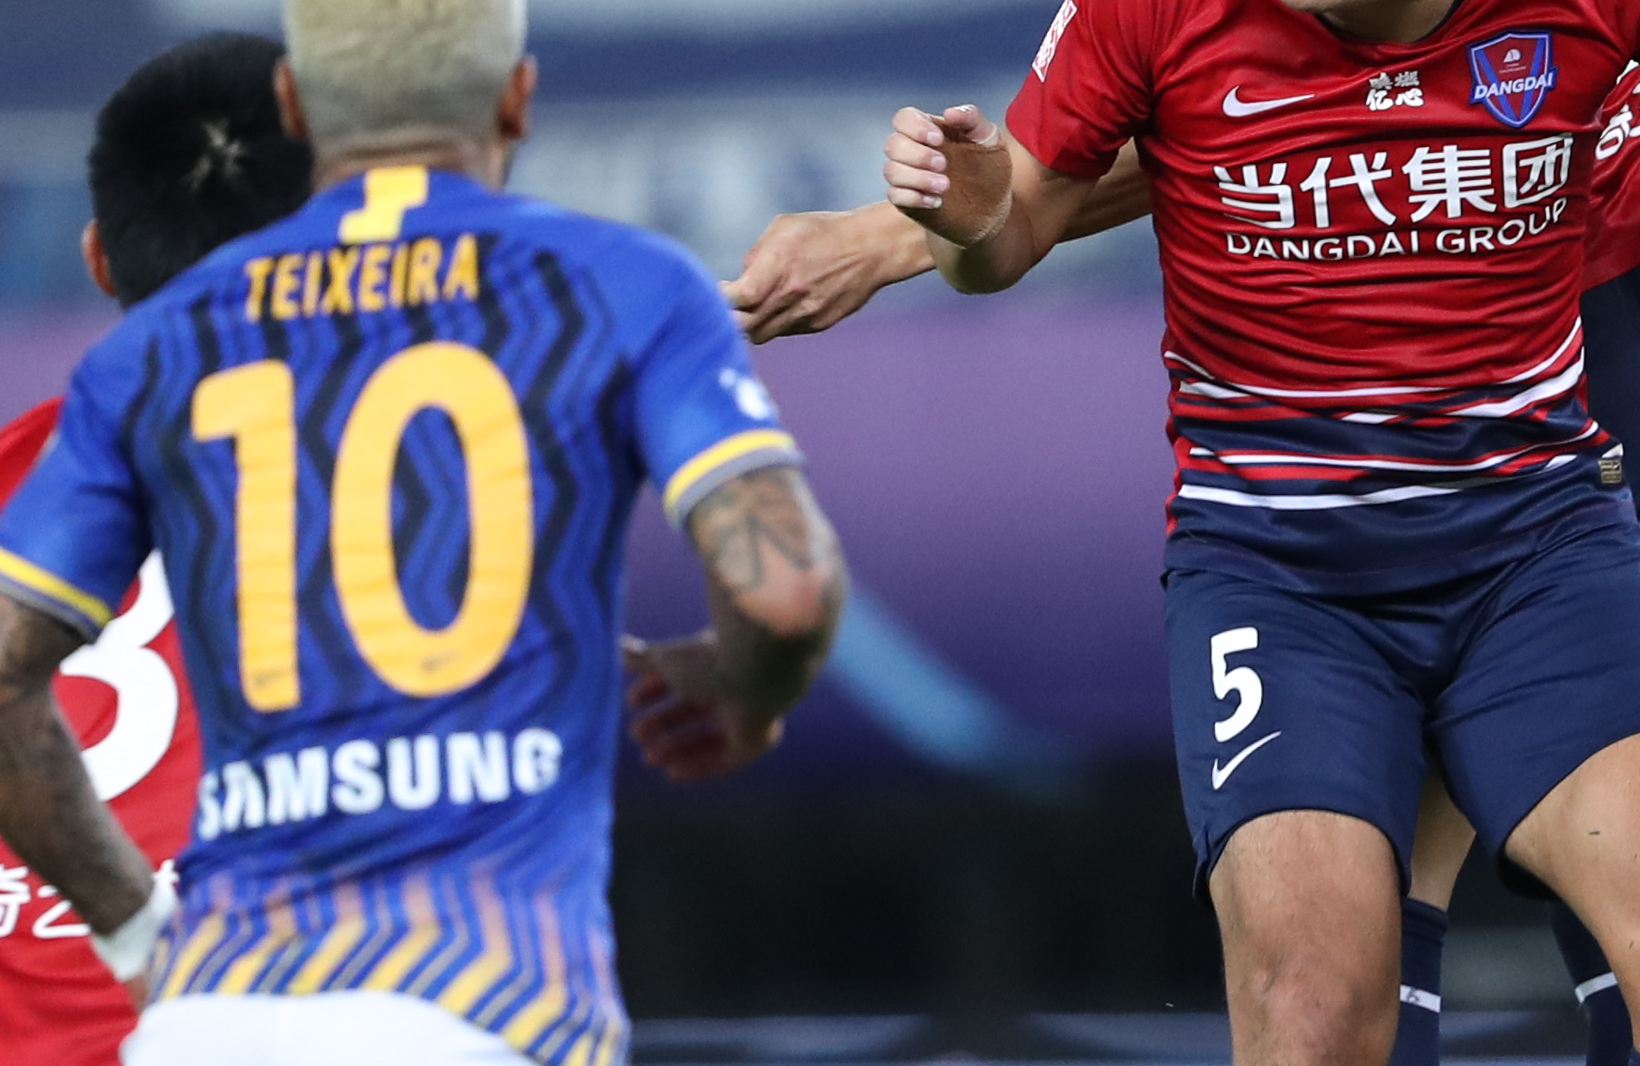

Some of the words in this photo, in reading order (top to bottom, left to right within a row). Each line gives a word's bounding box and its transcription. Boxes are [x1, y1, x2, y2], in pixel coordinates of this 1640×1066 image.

[1474, 72, 1554, 100] DANGDAI
[1213, 133, 1574, 229] 当代集团
[1224, 231, 1419, 261] DANGDAI
[1436, 197, 1567, 253] GROUP
[244, 232, 479, 324] TEIXEIRA
[191, 341, 534, 713] 10
[1211, 626, 1263, 743] 5
[197, 727, 562, 841] SAMSUNG
